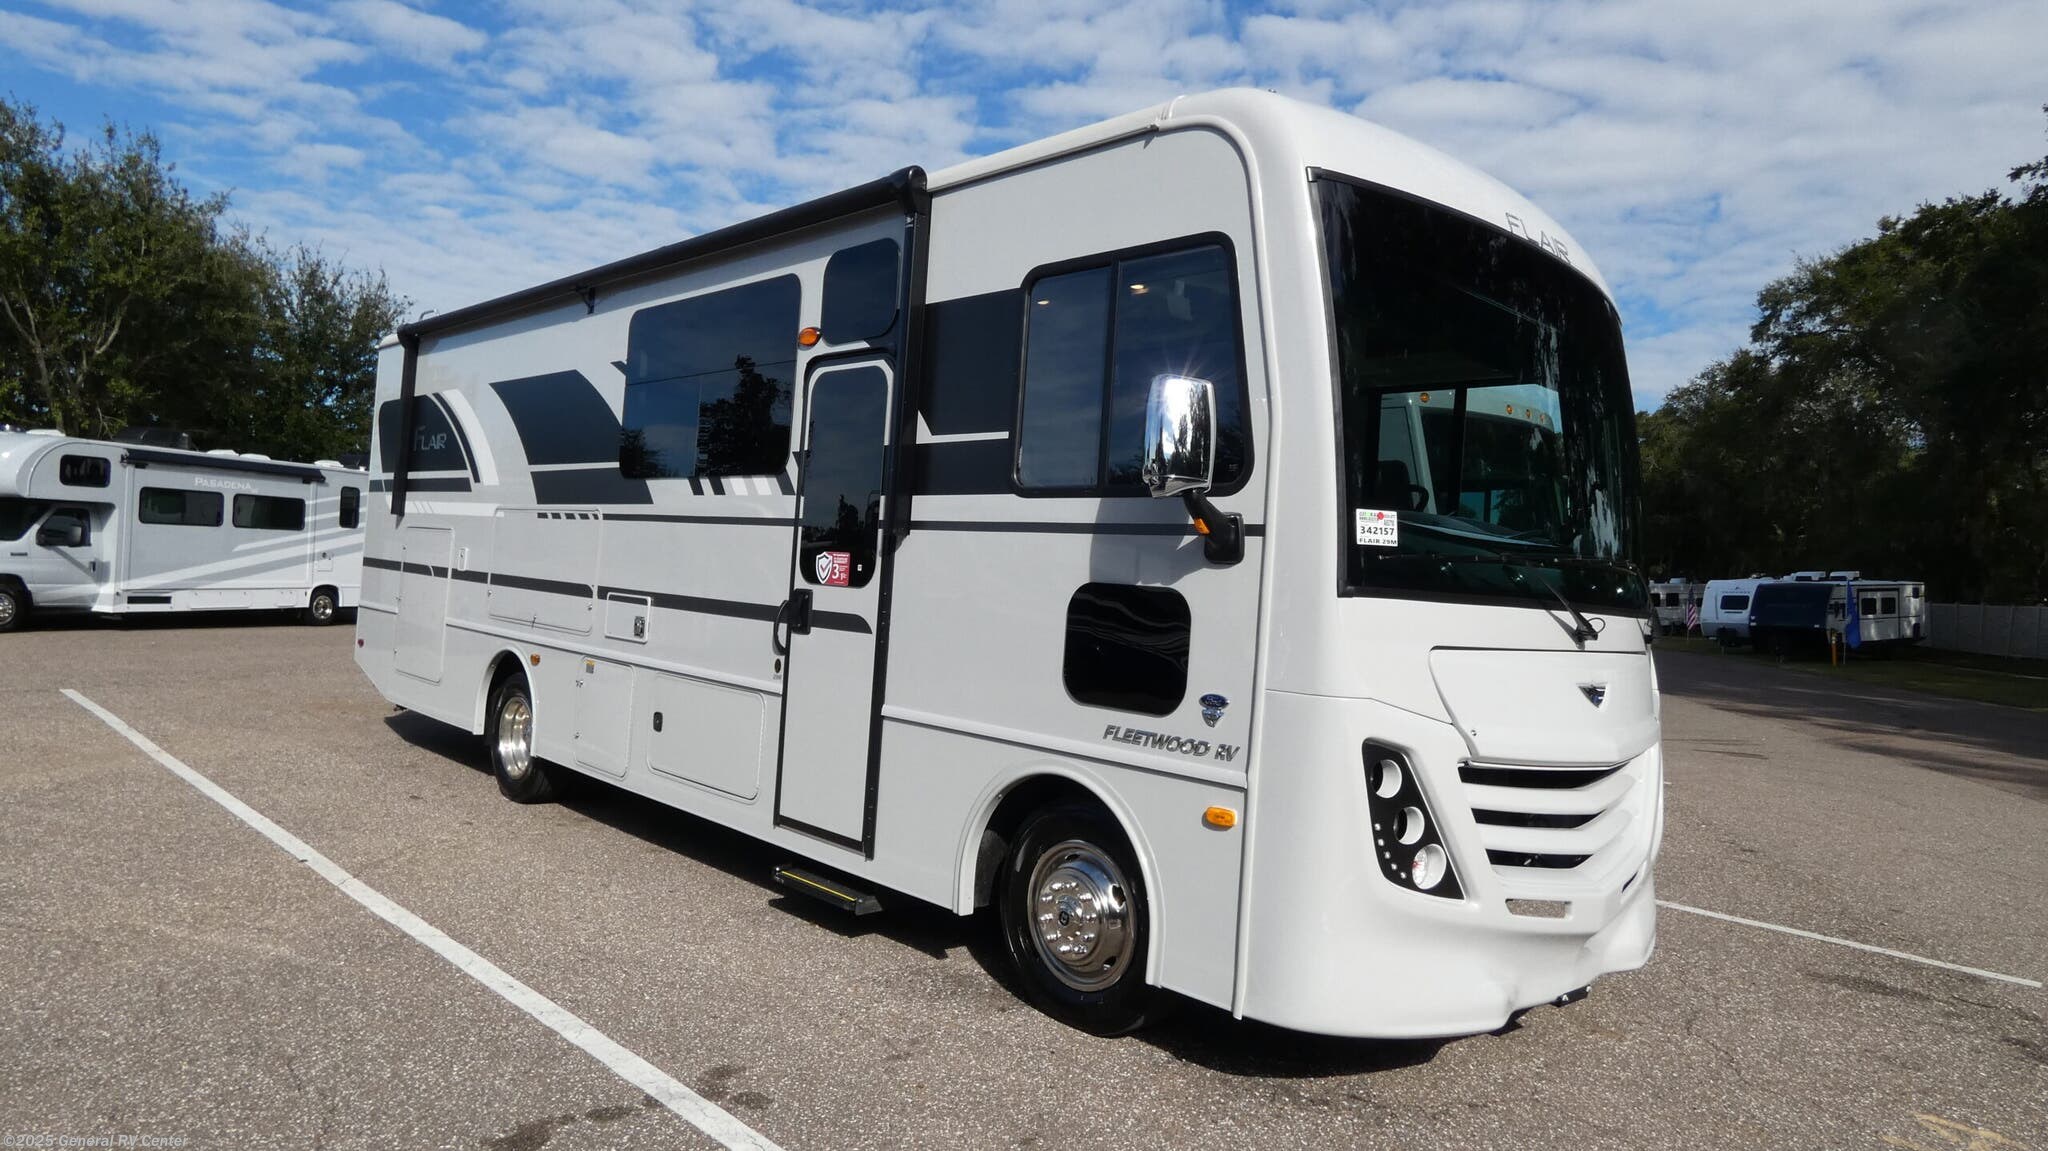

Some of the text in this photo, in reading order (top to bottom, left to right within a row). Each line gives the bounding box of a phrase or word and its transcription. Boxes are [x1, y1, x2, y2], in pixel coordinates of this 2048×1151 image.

[1505, 212, 1571, 265] FLAIR
[413, 425, 447, 451] FLAIR
[194, 477, 252, 490] PASADENA
[1360, 526, 1395, 536] 342157
[831, 563, 840, 579] 3
[1102, 724, 1241, 762] FLEETWOOD RV
